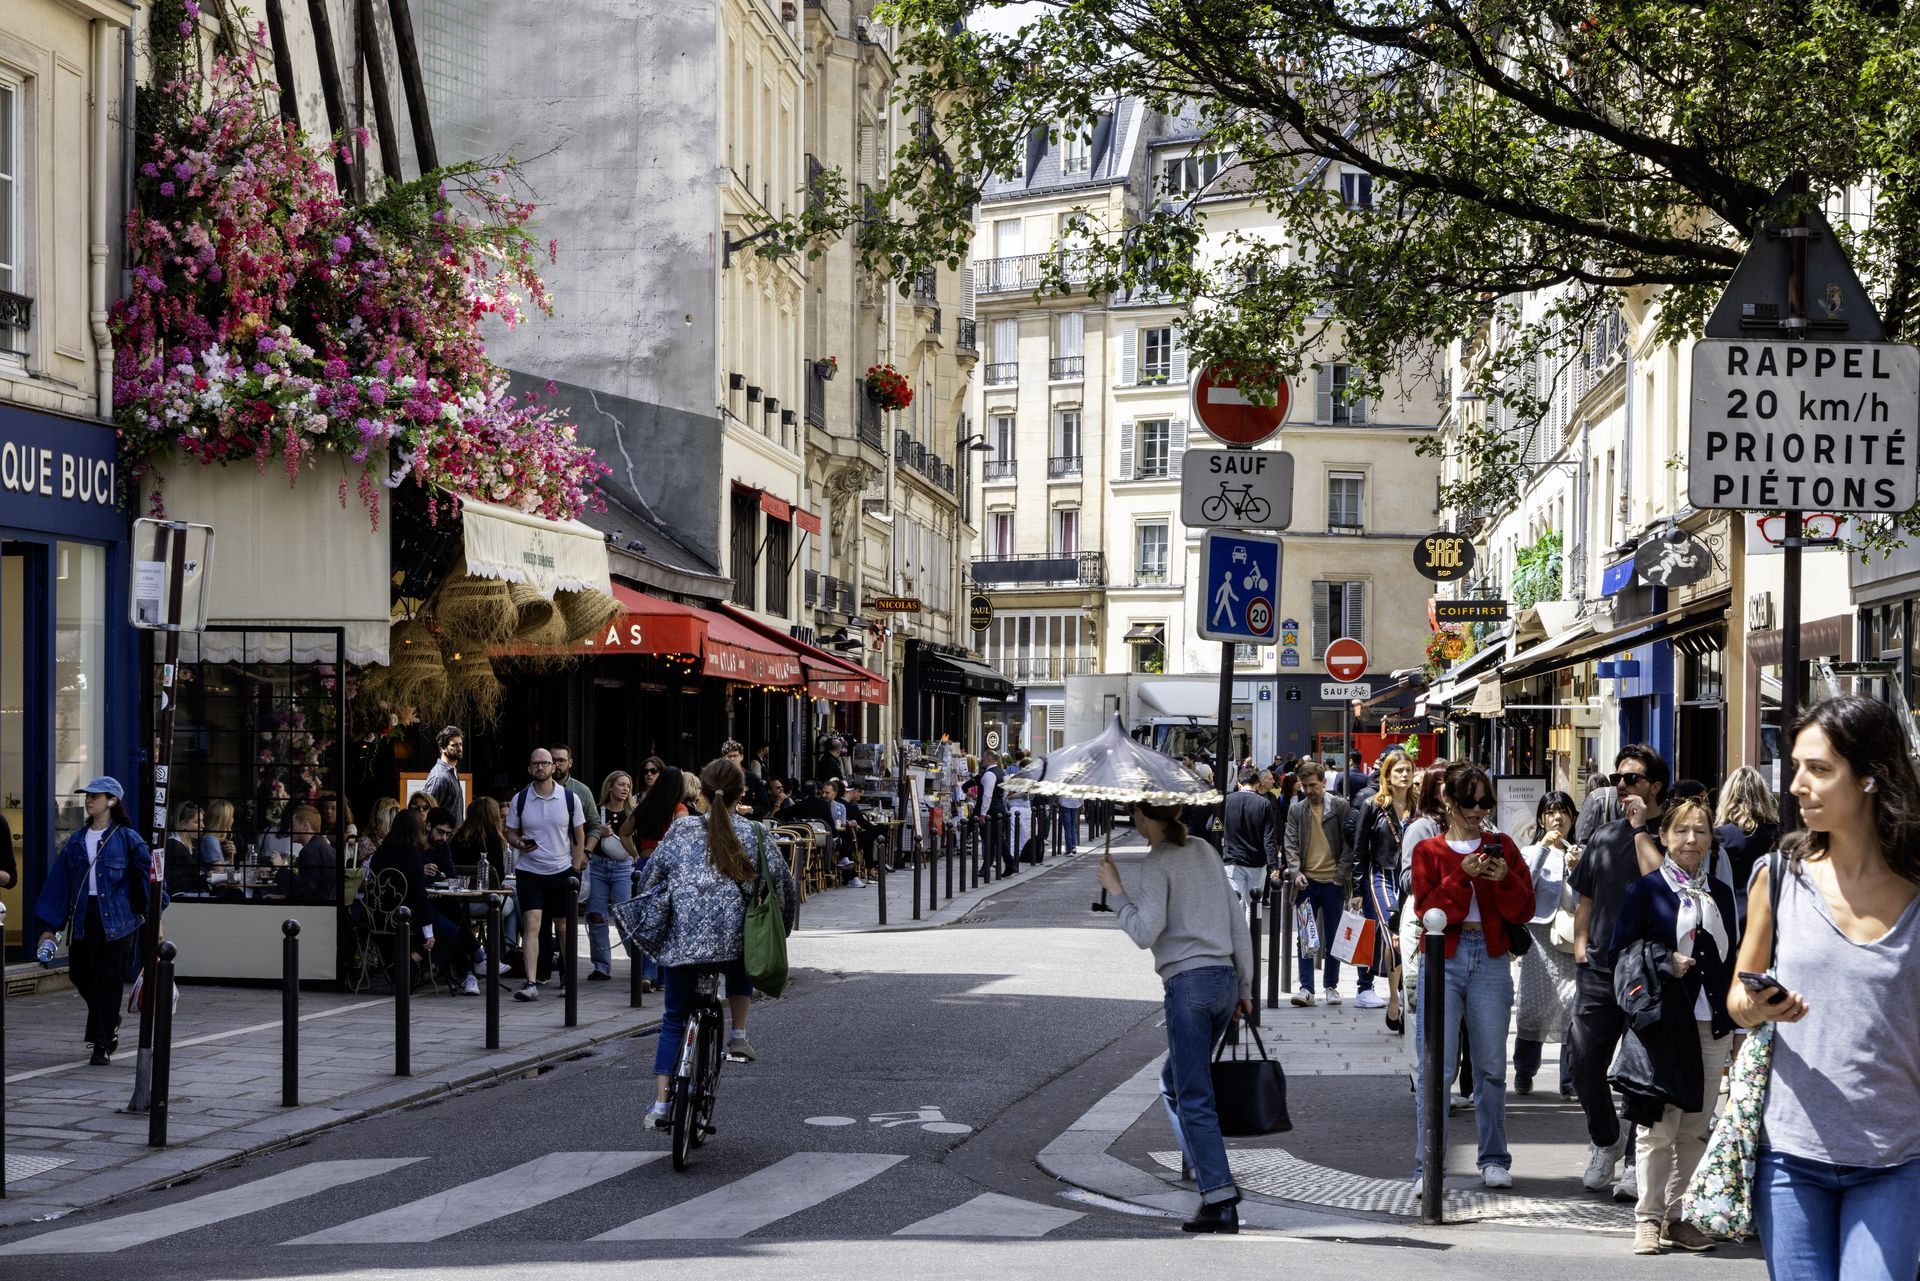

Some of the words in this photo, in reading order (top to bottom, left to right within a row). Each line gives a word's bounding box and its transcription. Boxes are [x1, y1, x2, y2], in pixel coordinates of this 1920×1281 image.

[1728, 346, 1890, 379] RAPPEL
[1727, 390, 1777, 419] 20
[1799, 391, 1889, 422] km/h
[1706, 429, 1905, 465] PRIORITÉ
[1, 441, 53, 495] QUE
[61, 454, 115, 506] BUCI
[1209, 455, 1268, 475] SAUF
[1713, 469, 1895, 508] PIÉTONS
[878, 599, 918, 610] NICOLAS
[1252, 609, 1267, 623] 20
